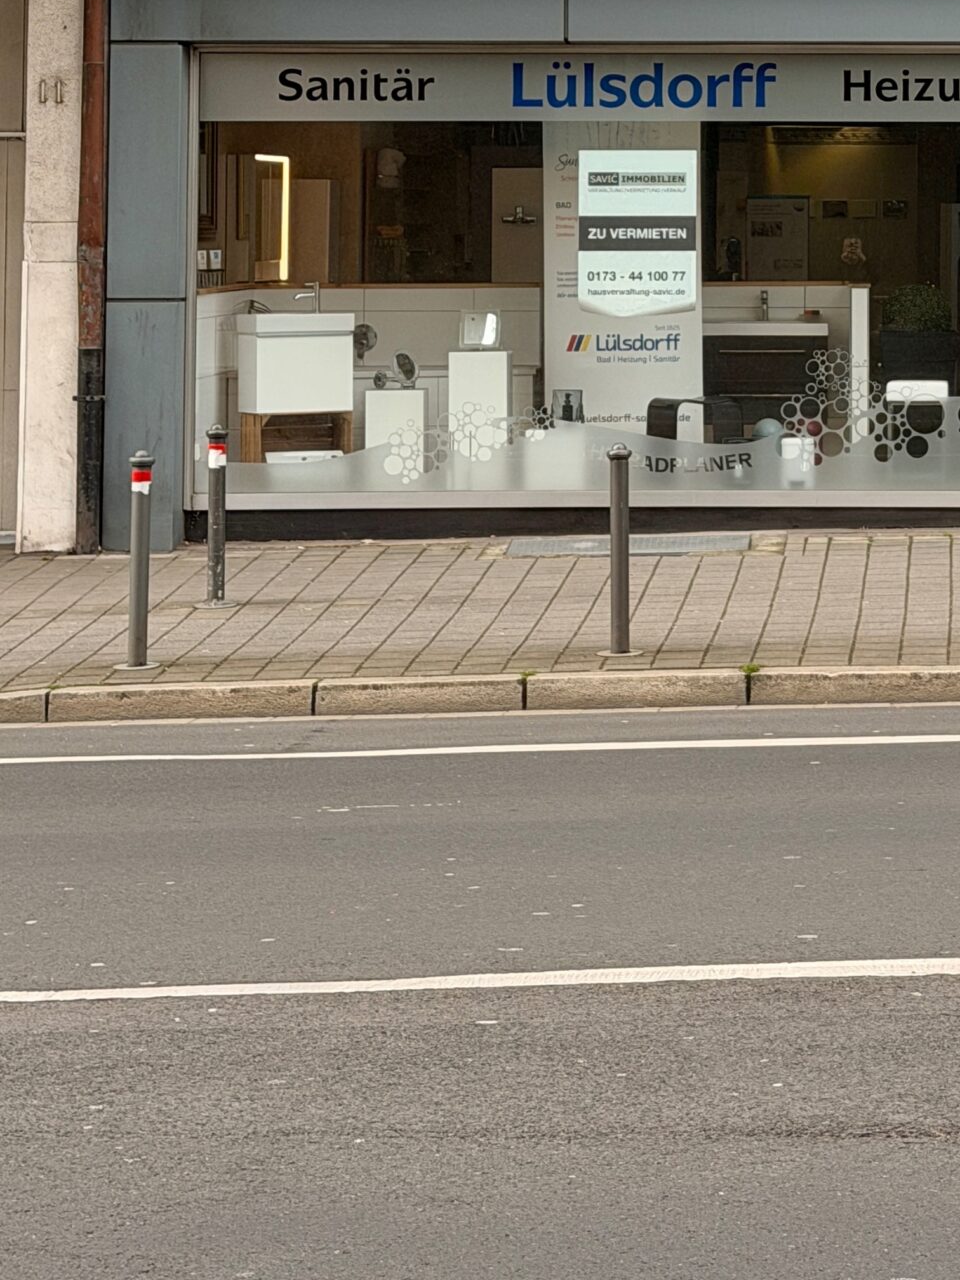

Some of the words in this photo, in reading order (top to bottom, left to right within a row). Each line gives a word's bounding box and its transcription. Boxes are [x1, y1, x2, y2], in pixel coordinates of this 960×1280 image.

[278, 68, 435, 102] Sanitär
[511, 61, 777, 109] Lülsdorff
[621, 175, 686, 184] IMMOBILIEN
[587, 228, 607, 240] ZU
[610, 228, 688, 240] VERMIETEN
[587, 271, 617, 282] 0173
[628, 271, 643, 281] 44
[647, 271, 669, 281] 100
[672, 271, 687, 281] 77
[596, 333, 681, 352] Lülsdorff
